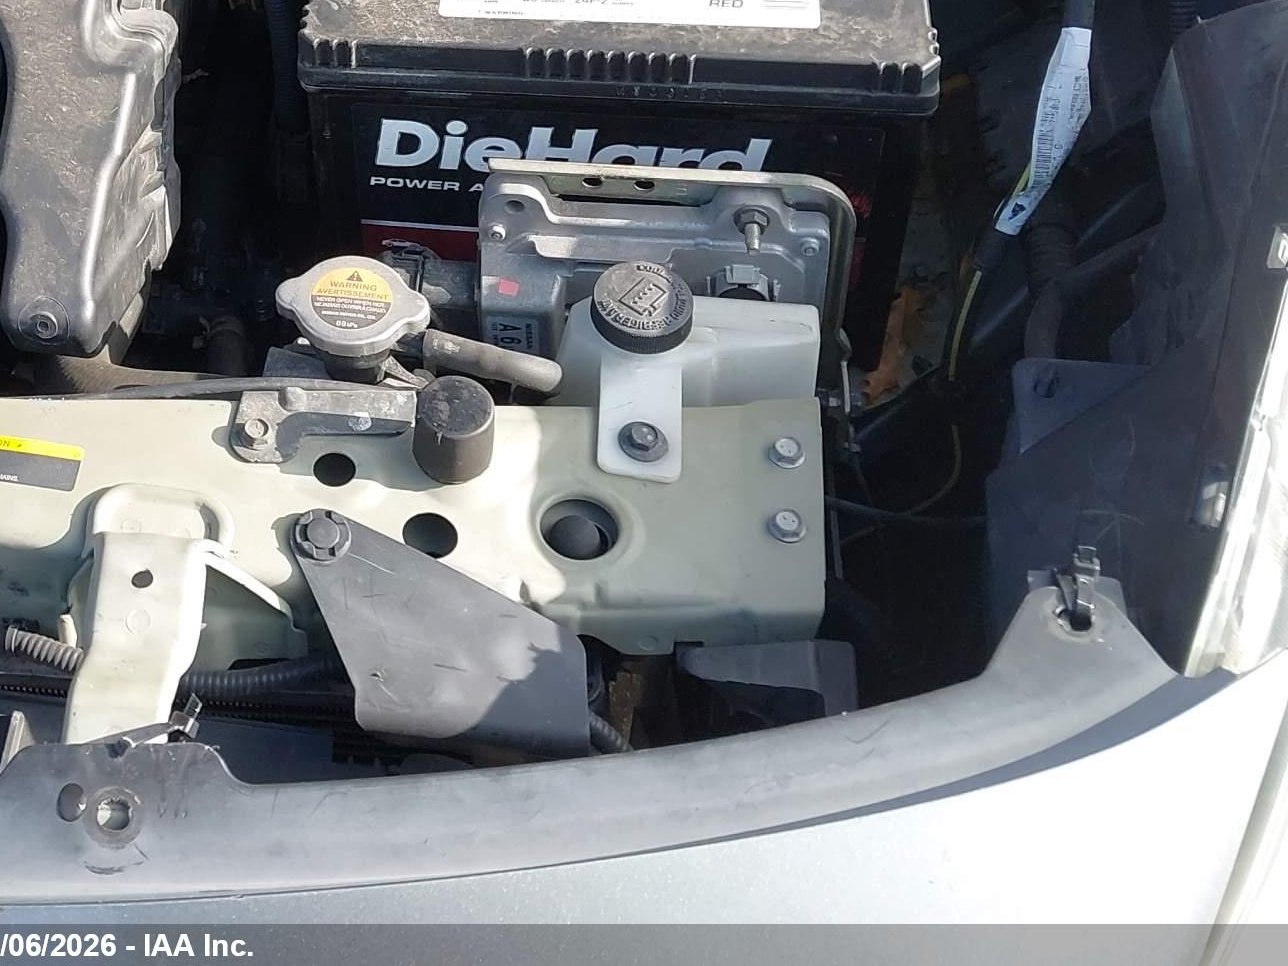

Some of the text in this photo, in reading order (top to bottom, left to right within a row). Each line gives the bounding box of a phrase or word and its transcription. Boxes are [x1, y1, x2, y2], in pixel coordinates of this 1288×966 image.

[369, 176, 460, 191] POWER
[330, 280, 377, 292] WARNING
[317, 288, 388, 300] AVERTISSEMENT
